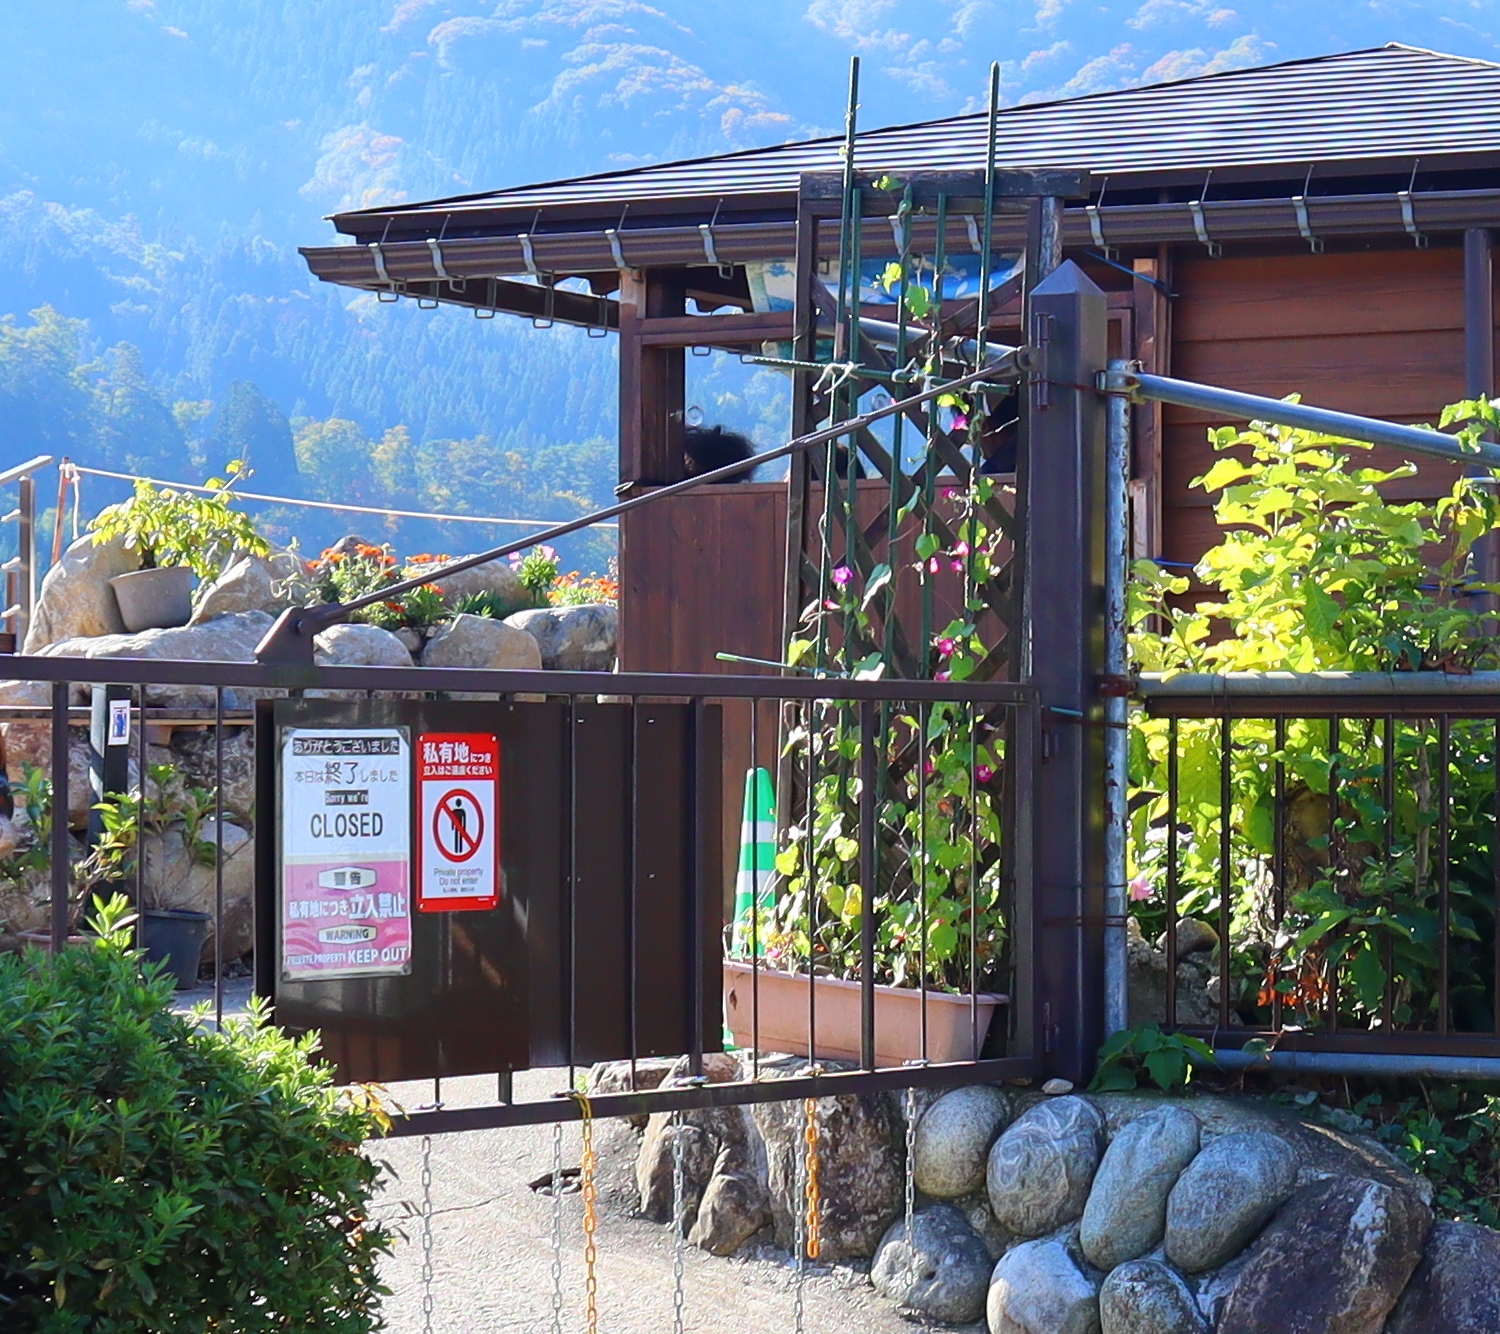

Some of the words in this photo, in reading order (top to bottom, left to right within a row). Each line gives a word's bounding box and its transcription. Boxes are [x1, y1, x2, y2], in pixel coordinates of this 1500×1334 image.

[422, 741, 492, 764] 私有地につき
[311, 812, 383, 838] CLOSED
[325, 928, 369, 941] WARNING
[348, 949, 378, 964] KEEP
[381, 947, 407, 962] OUT
